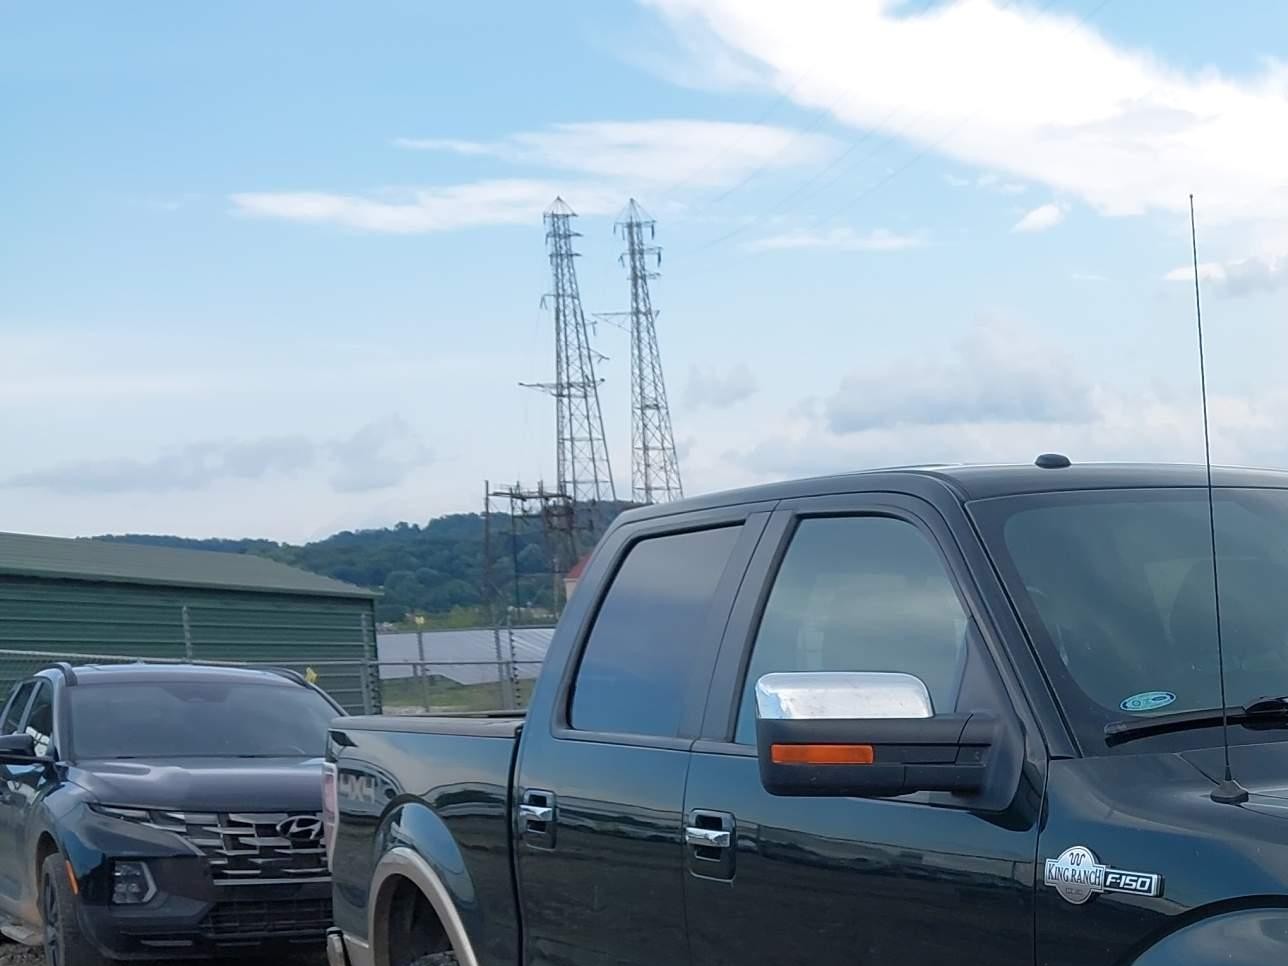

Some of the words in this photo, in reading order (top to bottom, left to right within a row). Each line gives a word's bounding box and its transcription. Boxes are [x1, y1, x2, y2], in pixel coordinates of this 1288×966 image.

[1047, 863, 1070, 883] KING
[1071, 867, 1102, 887] RANCH
[1105, 873, 1151, 891] F-150
